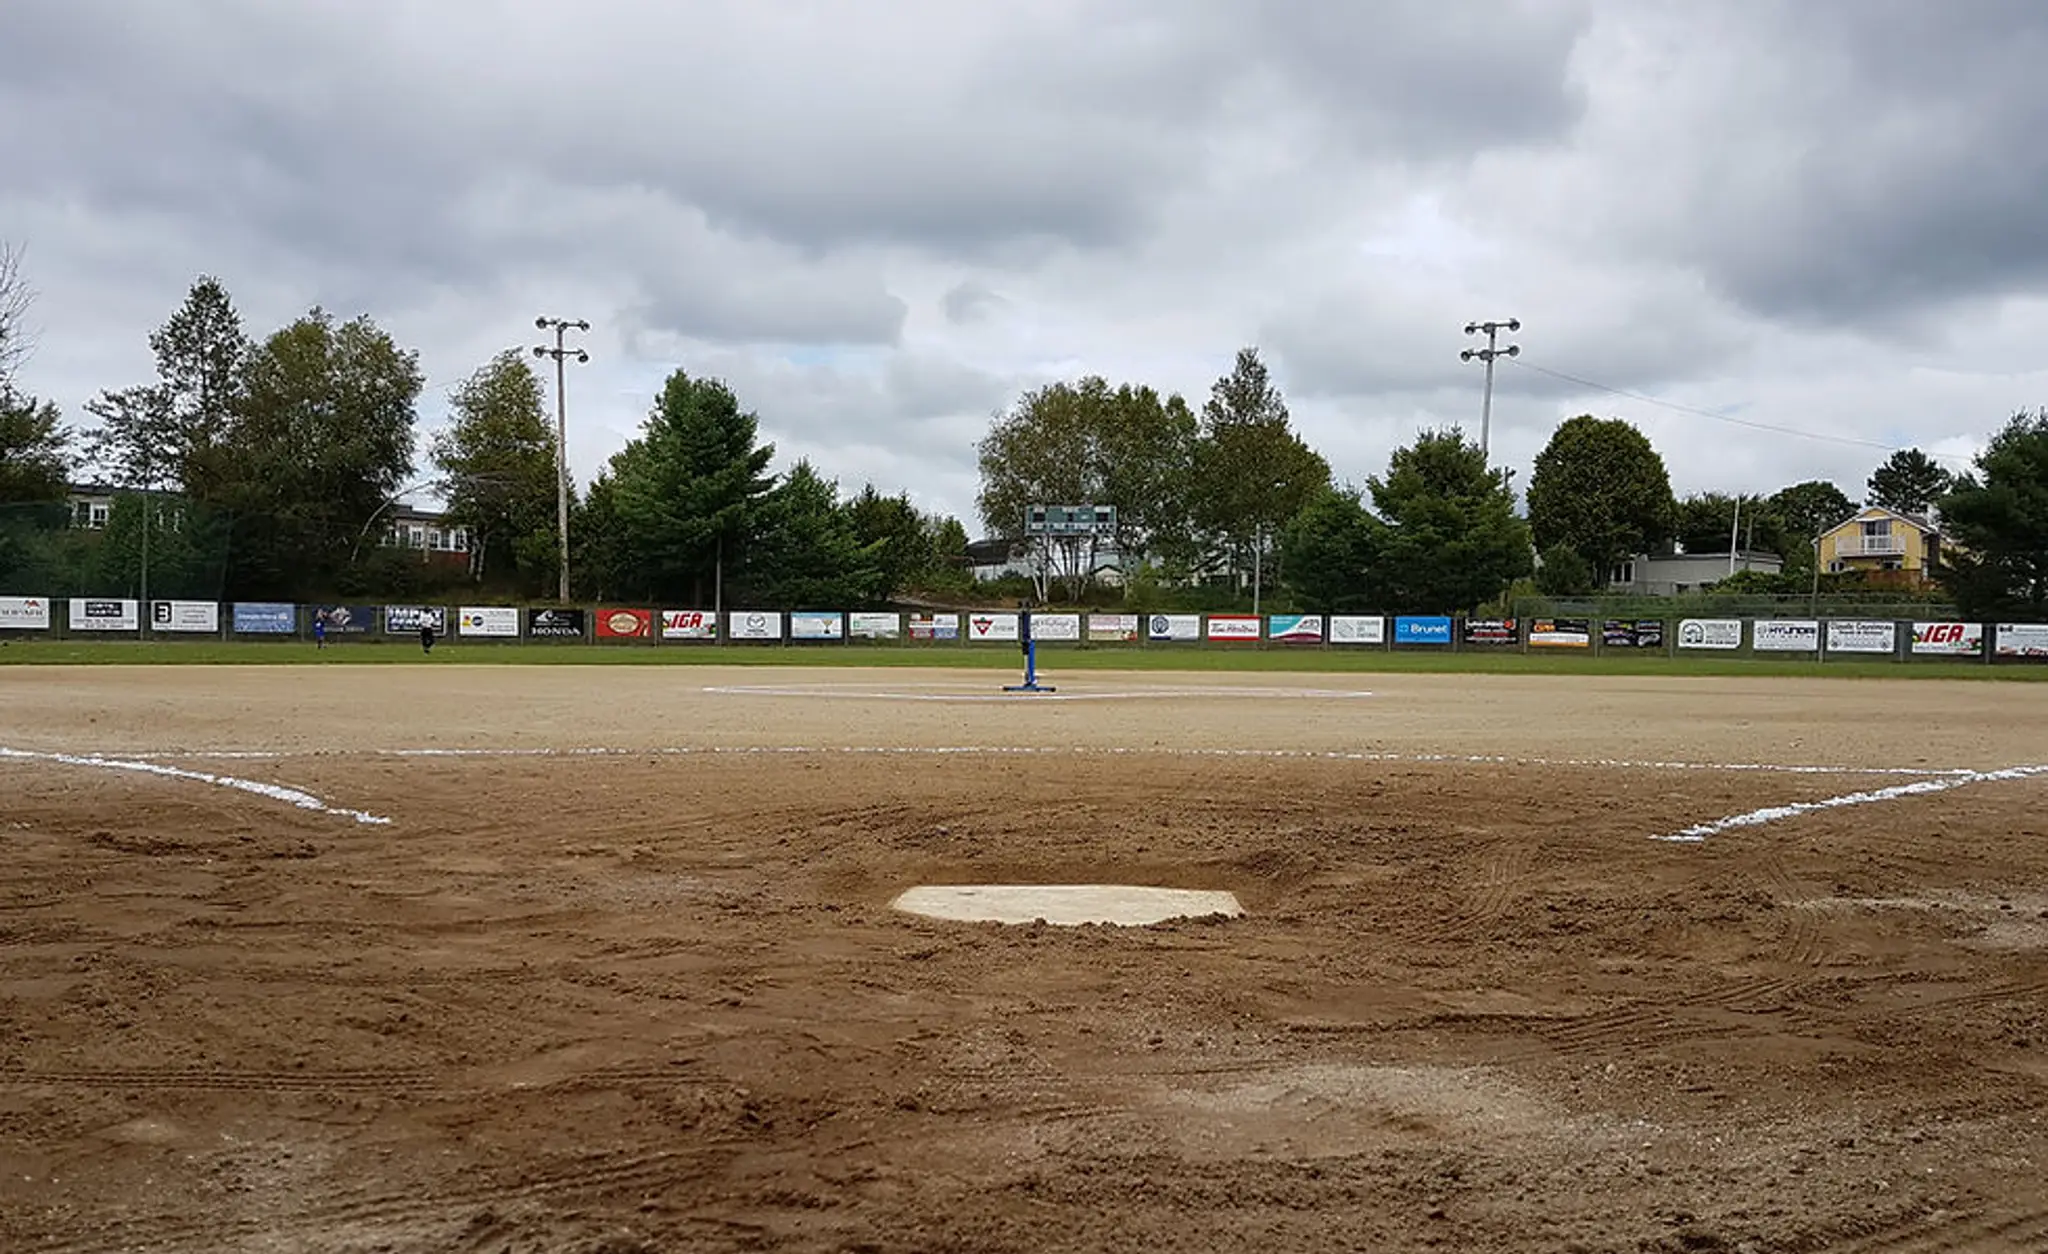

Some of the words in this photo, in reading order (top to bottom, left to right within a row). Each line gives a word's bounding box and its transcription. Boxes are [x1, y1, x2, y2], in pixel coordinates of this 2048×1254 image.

[670, 612, 704, 629] IGA
[530, 626, 581, 636] HONDA
[1210, 622, 1225, 634] Tim
[1410, 623, 1449, 635] Brunet
[1770, 626, 1816, 635] HYUNDAI
[1923, 624, 1966, 643] IGA
